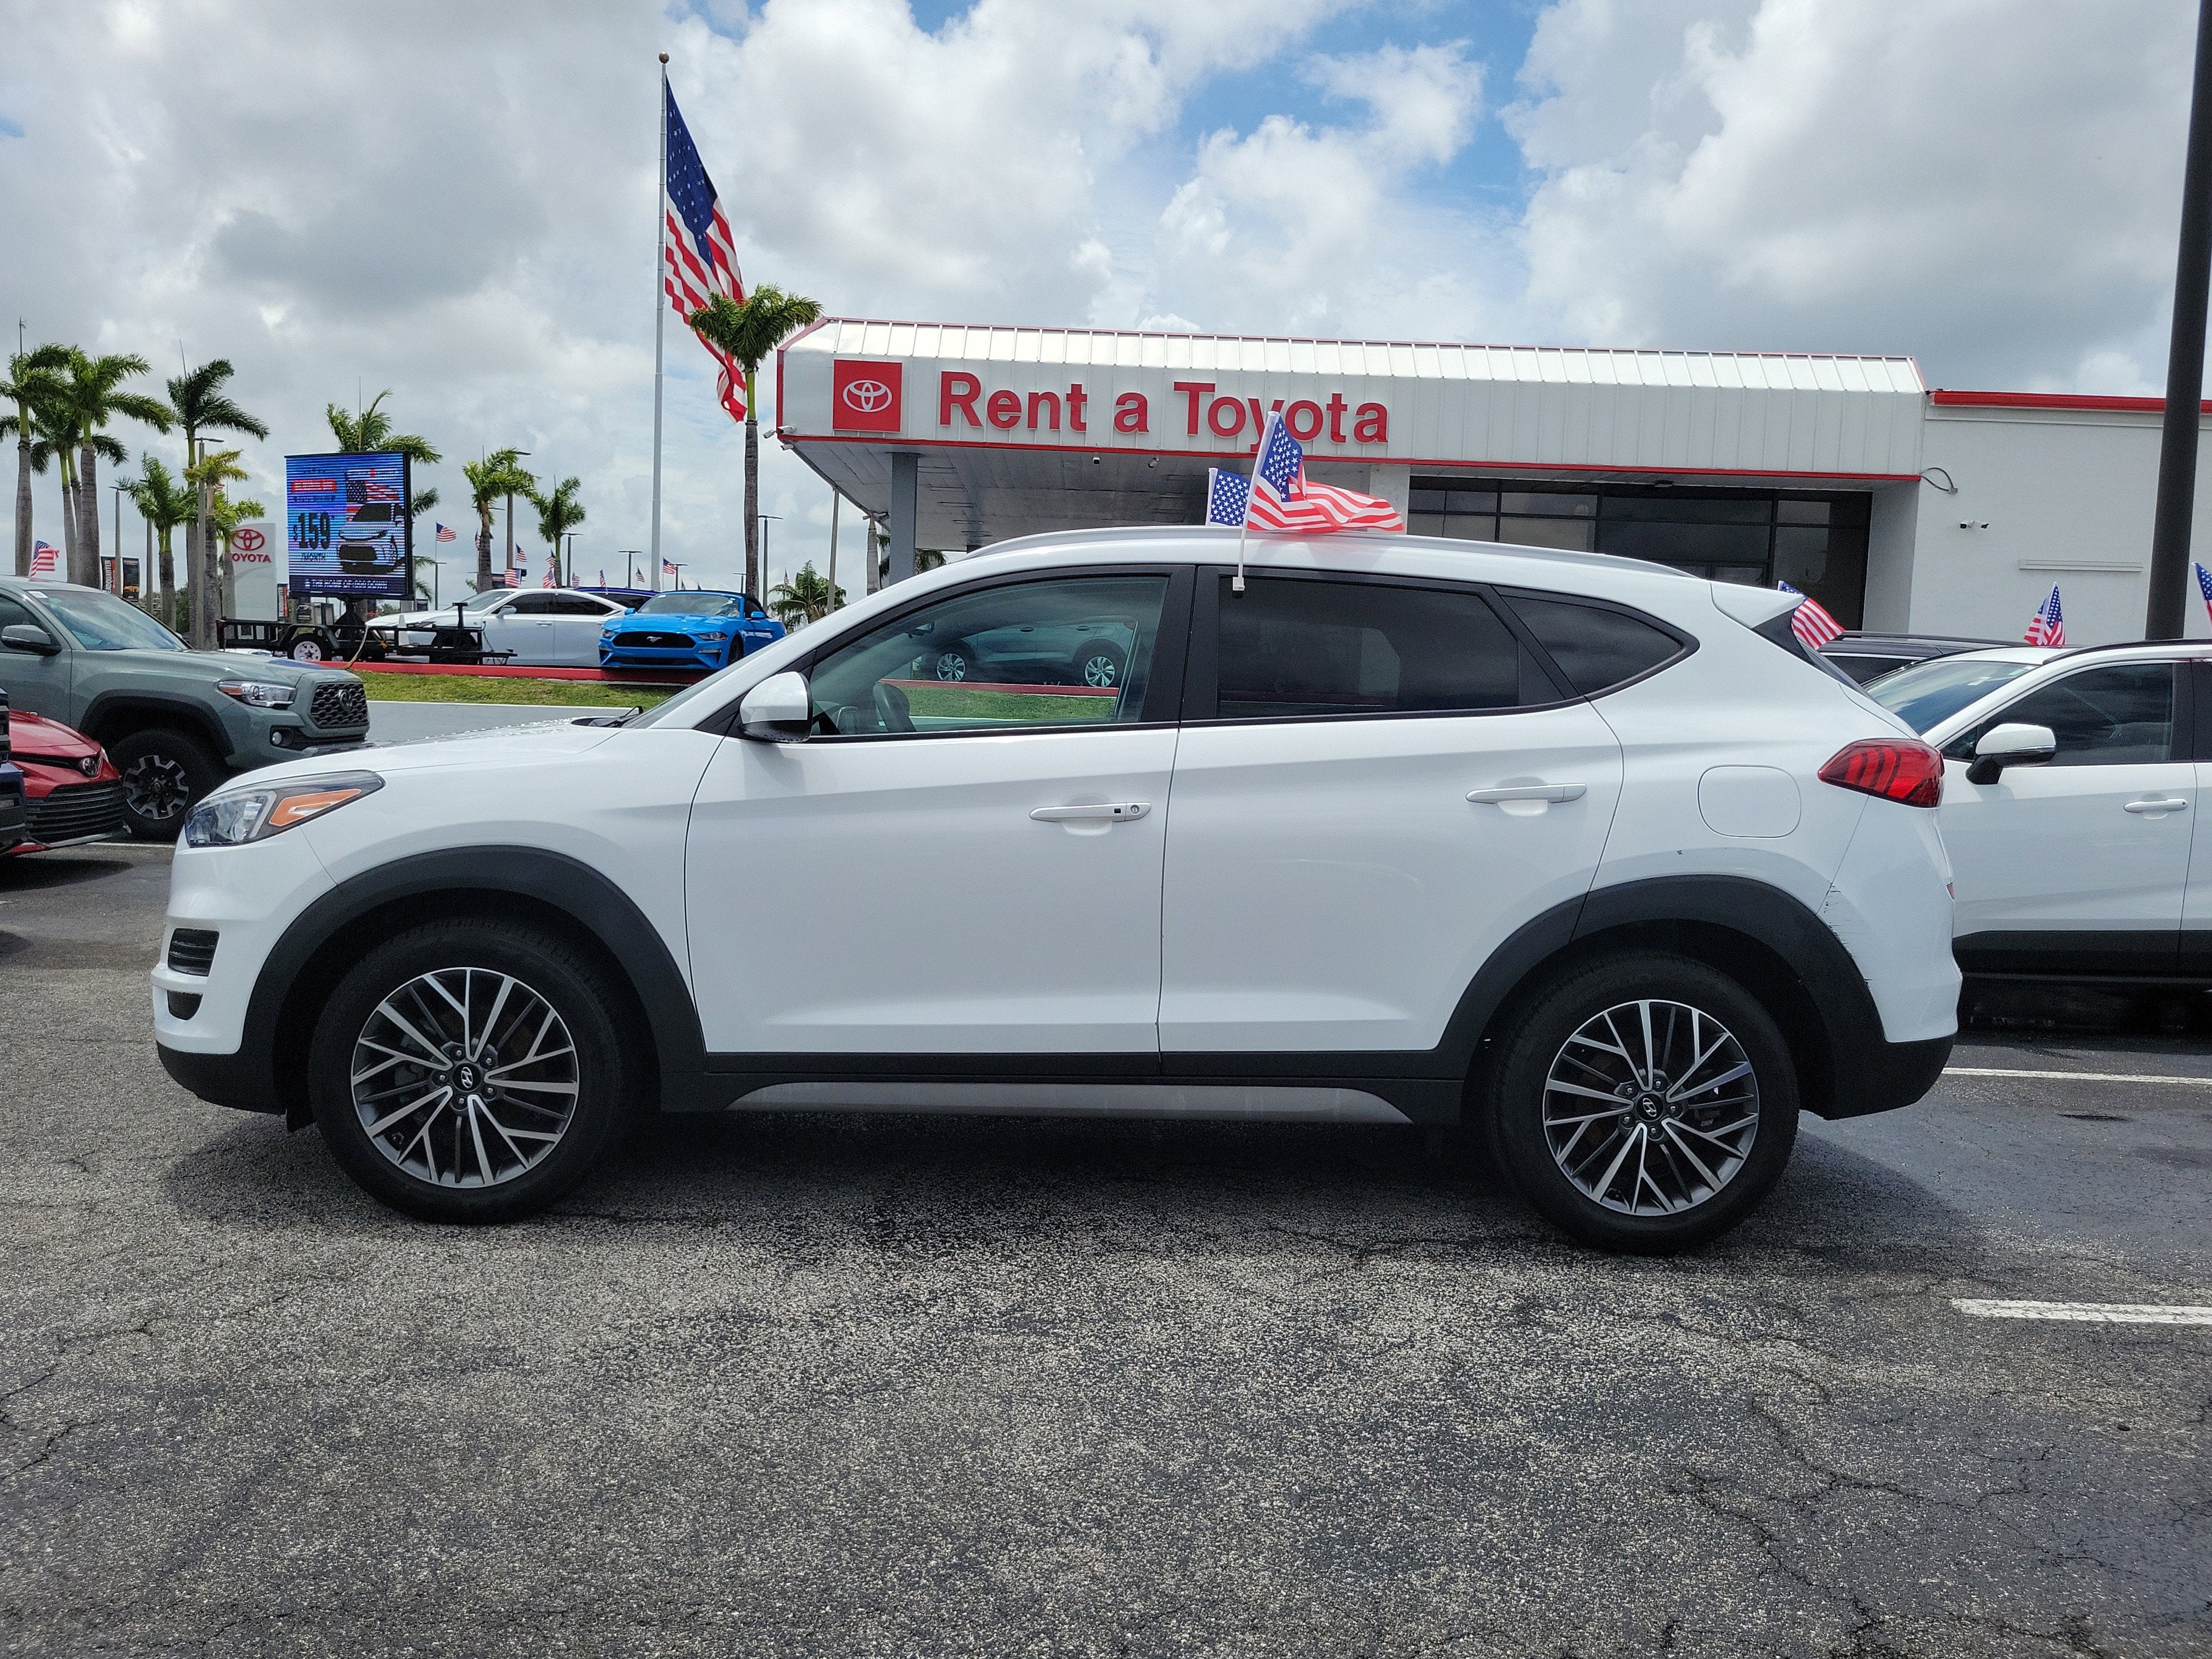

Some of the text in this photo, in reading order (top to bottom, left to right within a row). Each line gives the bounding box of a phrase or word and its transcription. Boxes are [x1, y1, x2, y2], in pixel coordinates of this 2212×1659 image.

[940, 371, 1387, 453] Rent a Toyota
[231, 553, 272, 563] OYOTA
